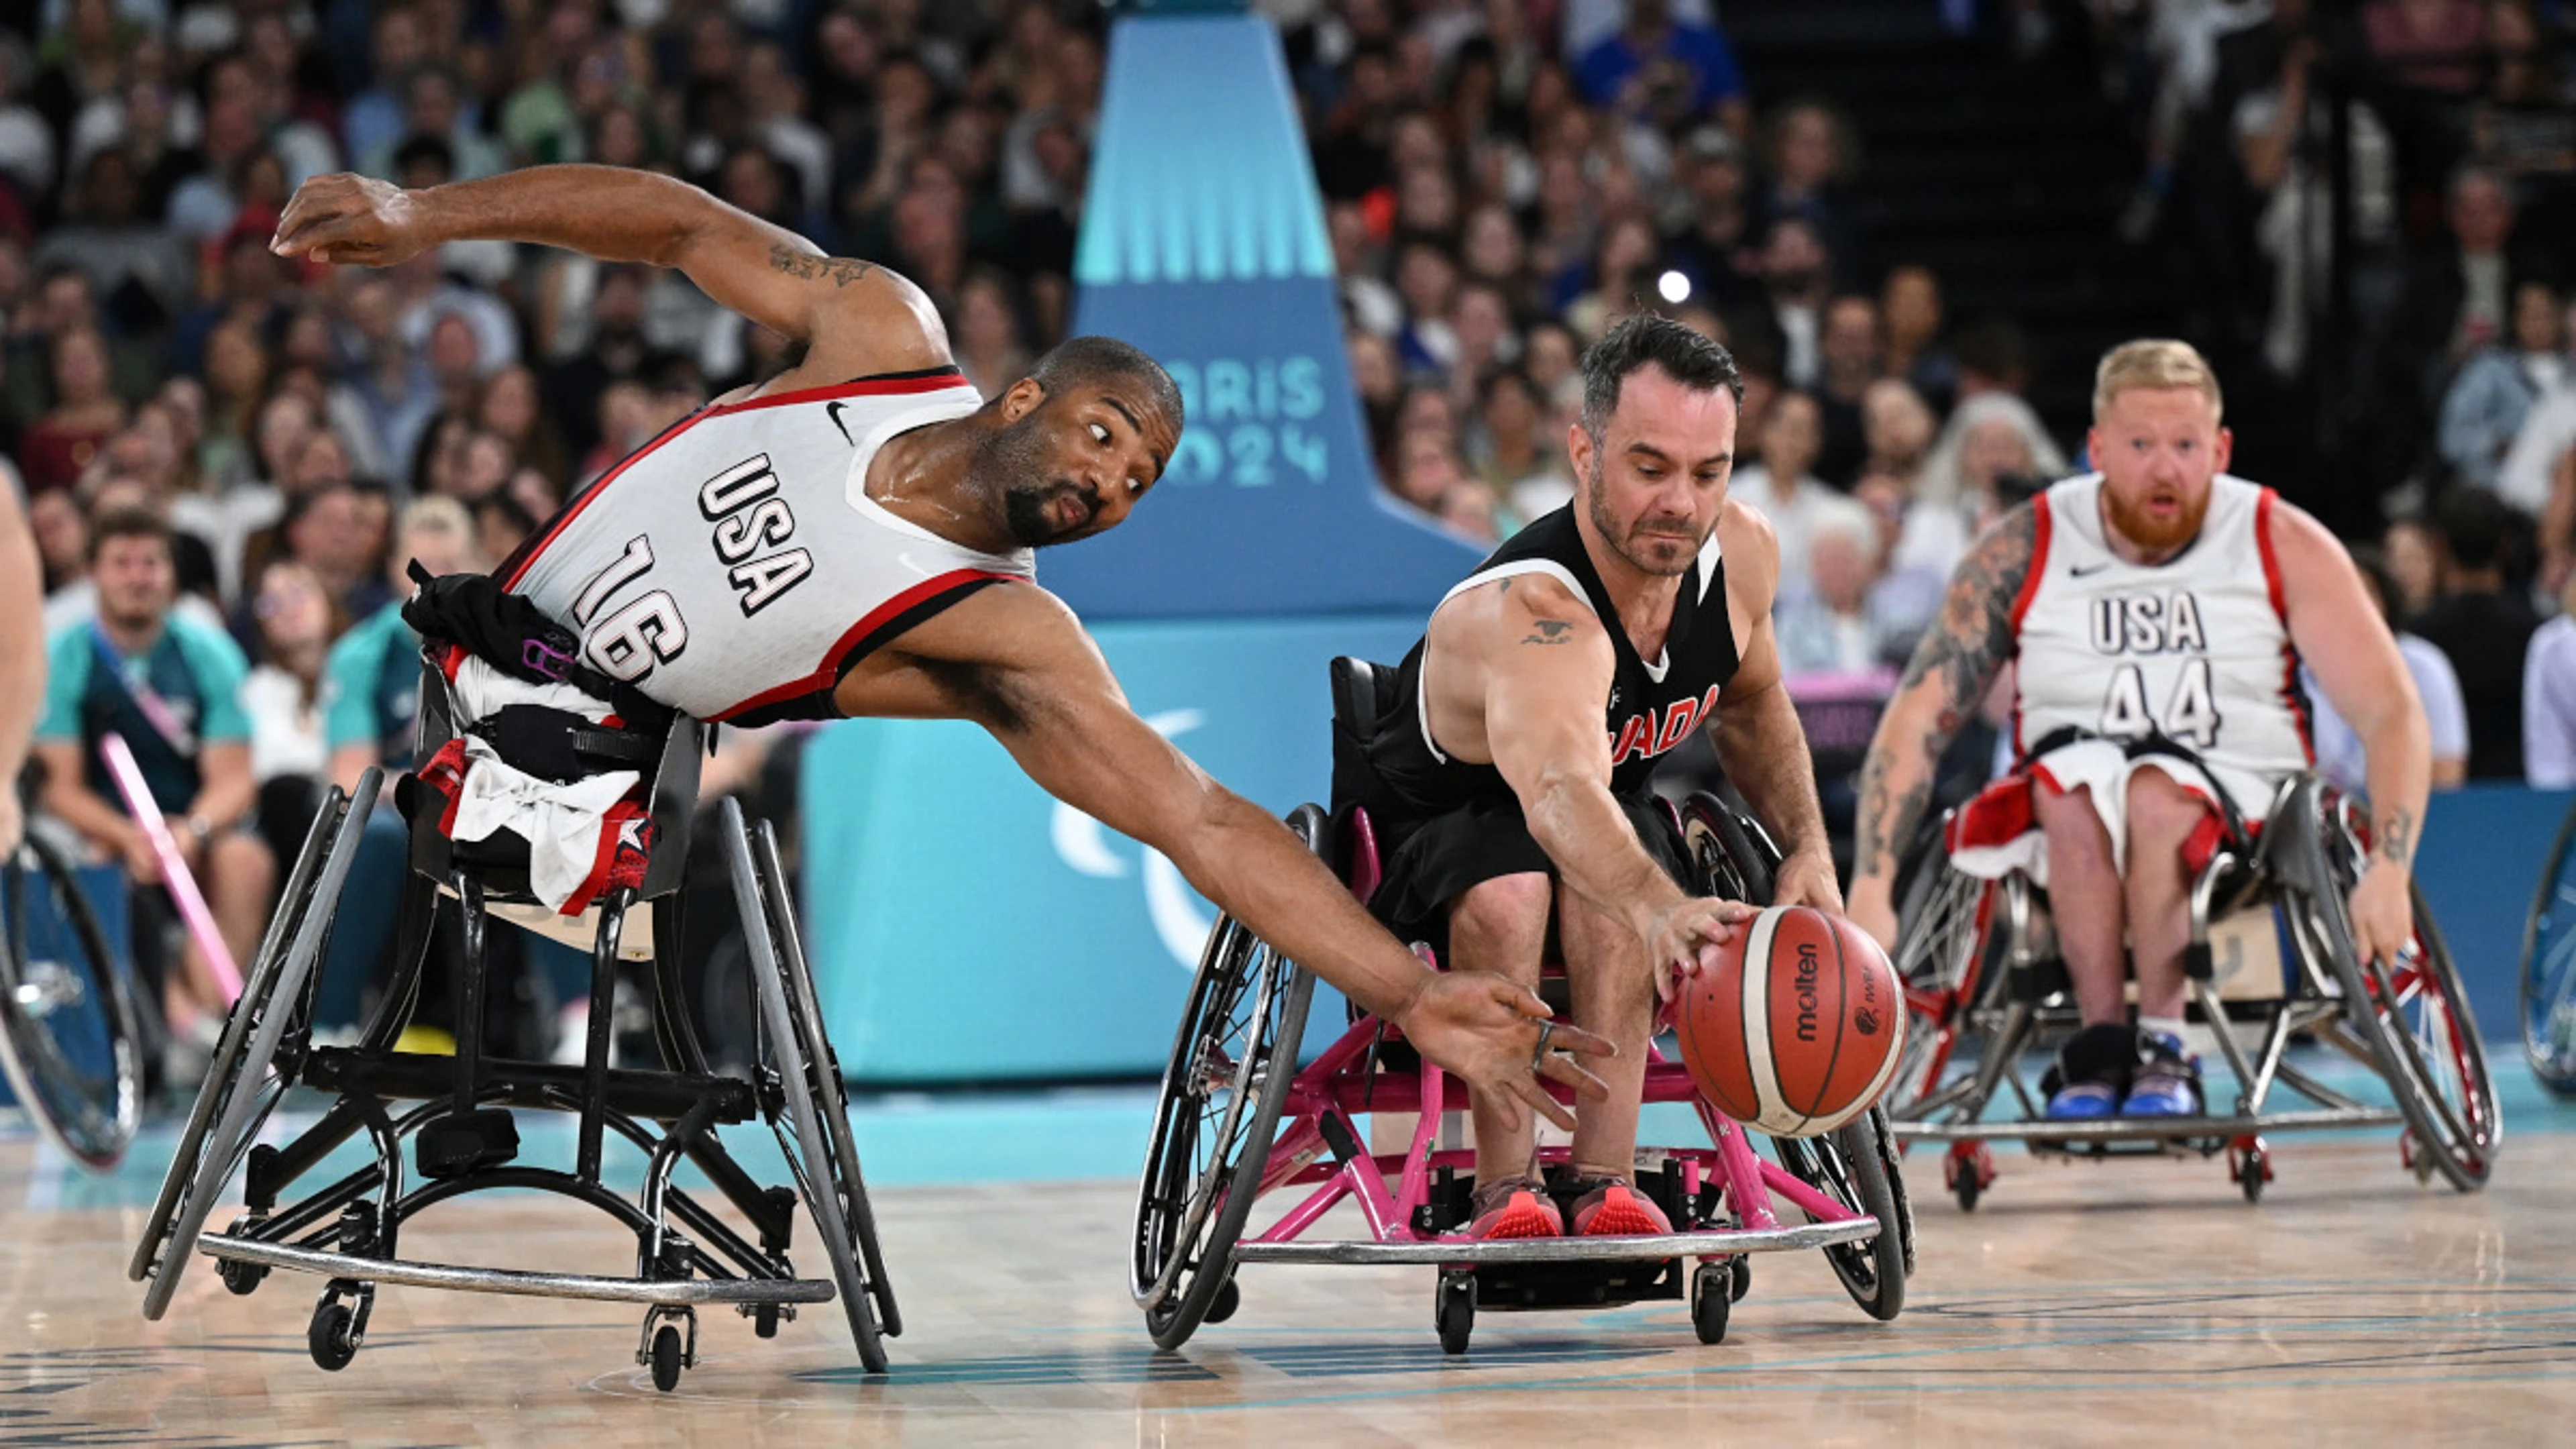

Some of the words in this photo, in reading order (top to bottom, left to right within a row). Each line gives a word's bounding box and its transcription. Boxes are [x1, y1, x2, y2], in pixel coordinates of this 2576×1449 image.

[1164, 421, 1328, 488] 024
[698, 452, 814, 618] USA
[573, 533, 688, 683] 16
[2091, 591, 2206, 655] USA
[2100, 659, 2221, 747] 44
[1795, 943, 1818, 1042] molten
